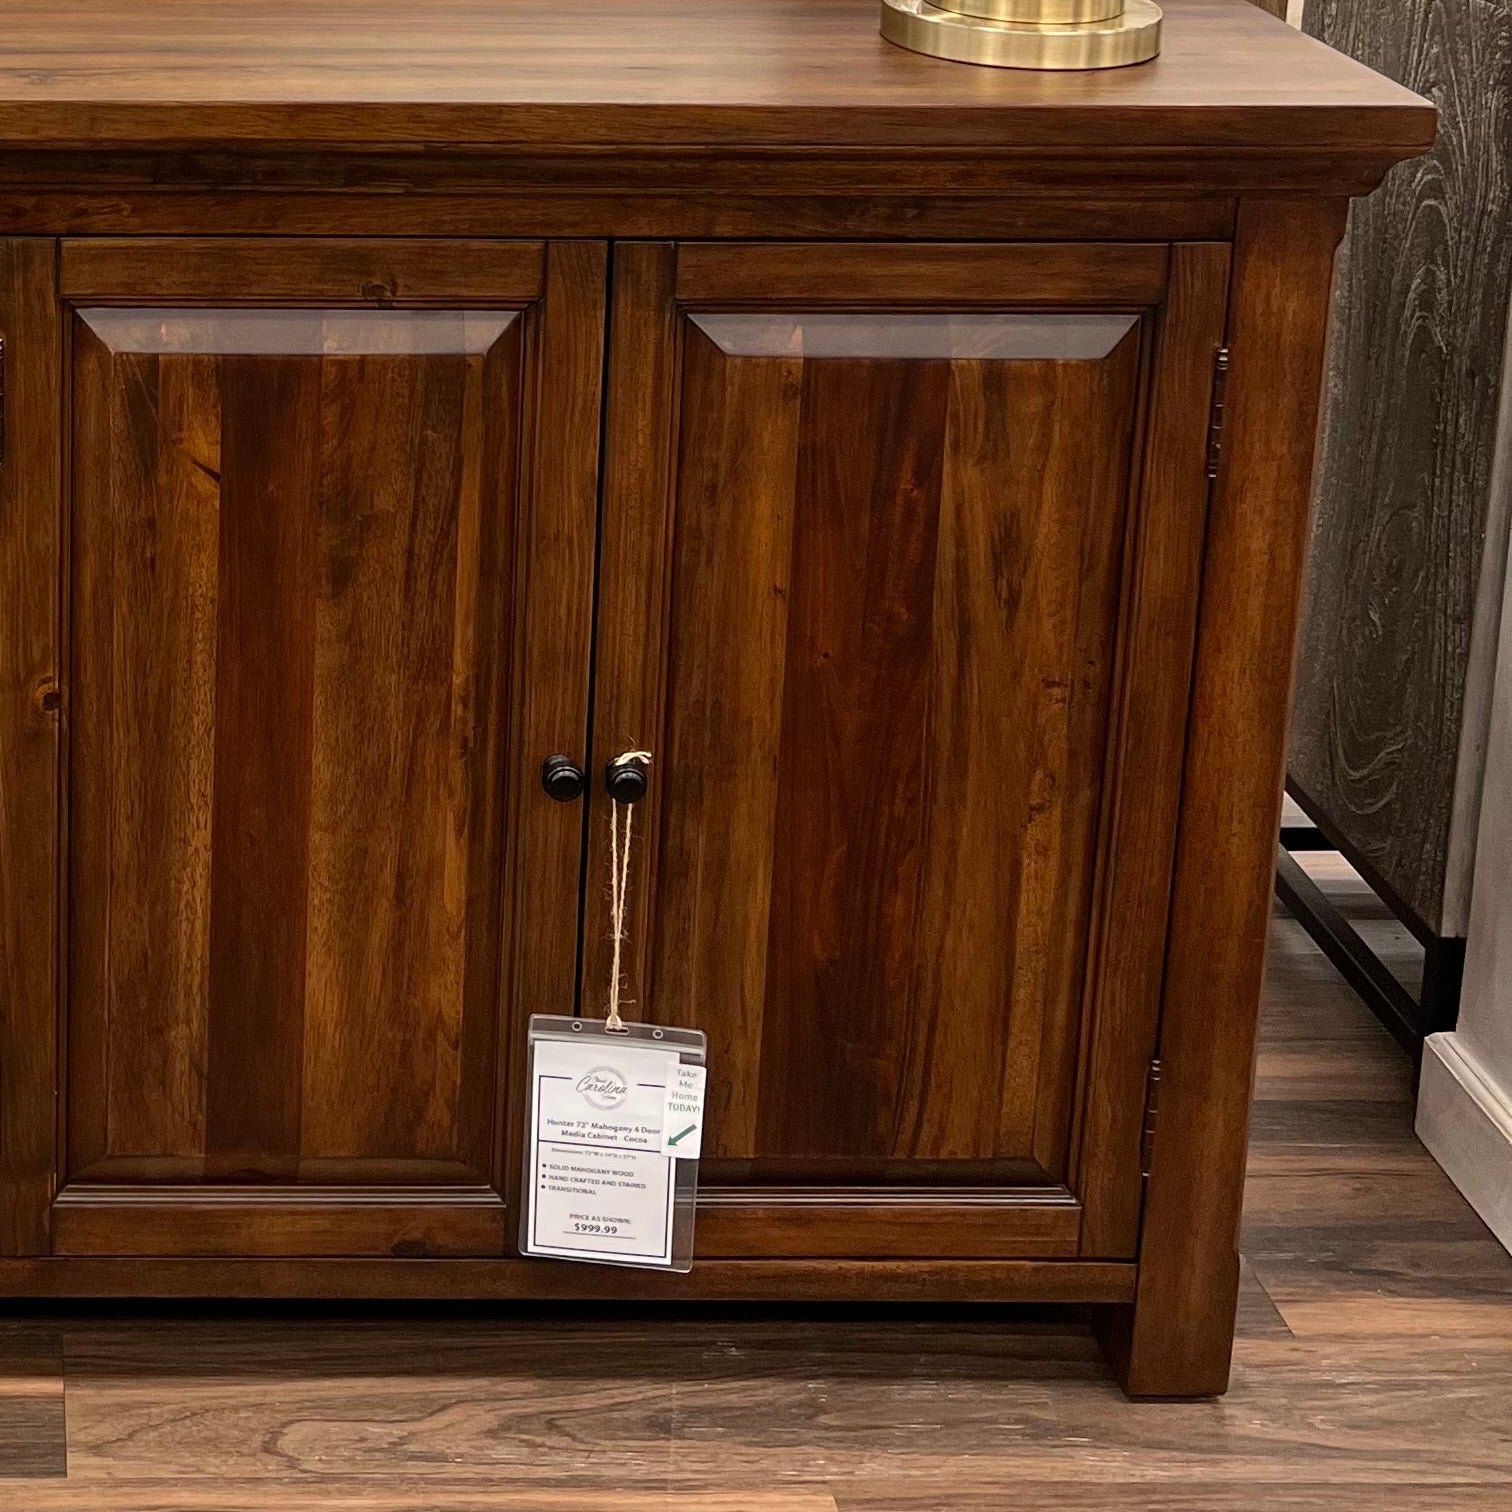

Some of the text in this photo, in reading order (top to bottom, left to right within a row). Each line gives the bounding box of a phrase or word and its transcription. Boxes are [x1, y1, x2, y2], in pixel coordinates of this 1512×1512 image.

[677, 1068, 698, 1078] Take
[576, 1075, 628, 1094] Carolina
[679, 1080, 694, 1089] Me
[672, 1090, 698, 1102] Home
[668, 1102, 700, 1114] TODAY!
[547, 1118, 574, 1128] Hunter
[591, 1122, 633, 1133] Mahogany
[561, 1130, 648, 1144] Media Cabinet Cocoa
[571, 1166, 610, 1176] MAHOGANY
[570, 1177, 600, 1185] CRAFTED
[618, 1181, 646, 1189] STAINED
[548, 1186, 597, 1195] TRANSITIONAL
[569, 1213, 589, 1221] PRICE
[574, 1223, 617, 1235] $999.99
